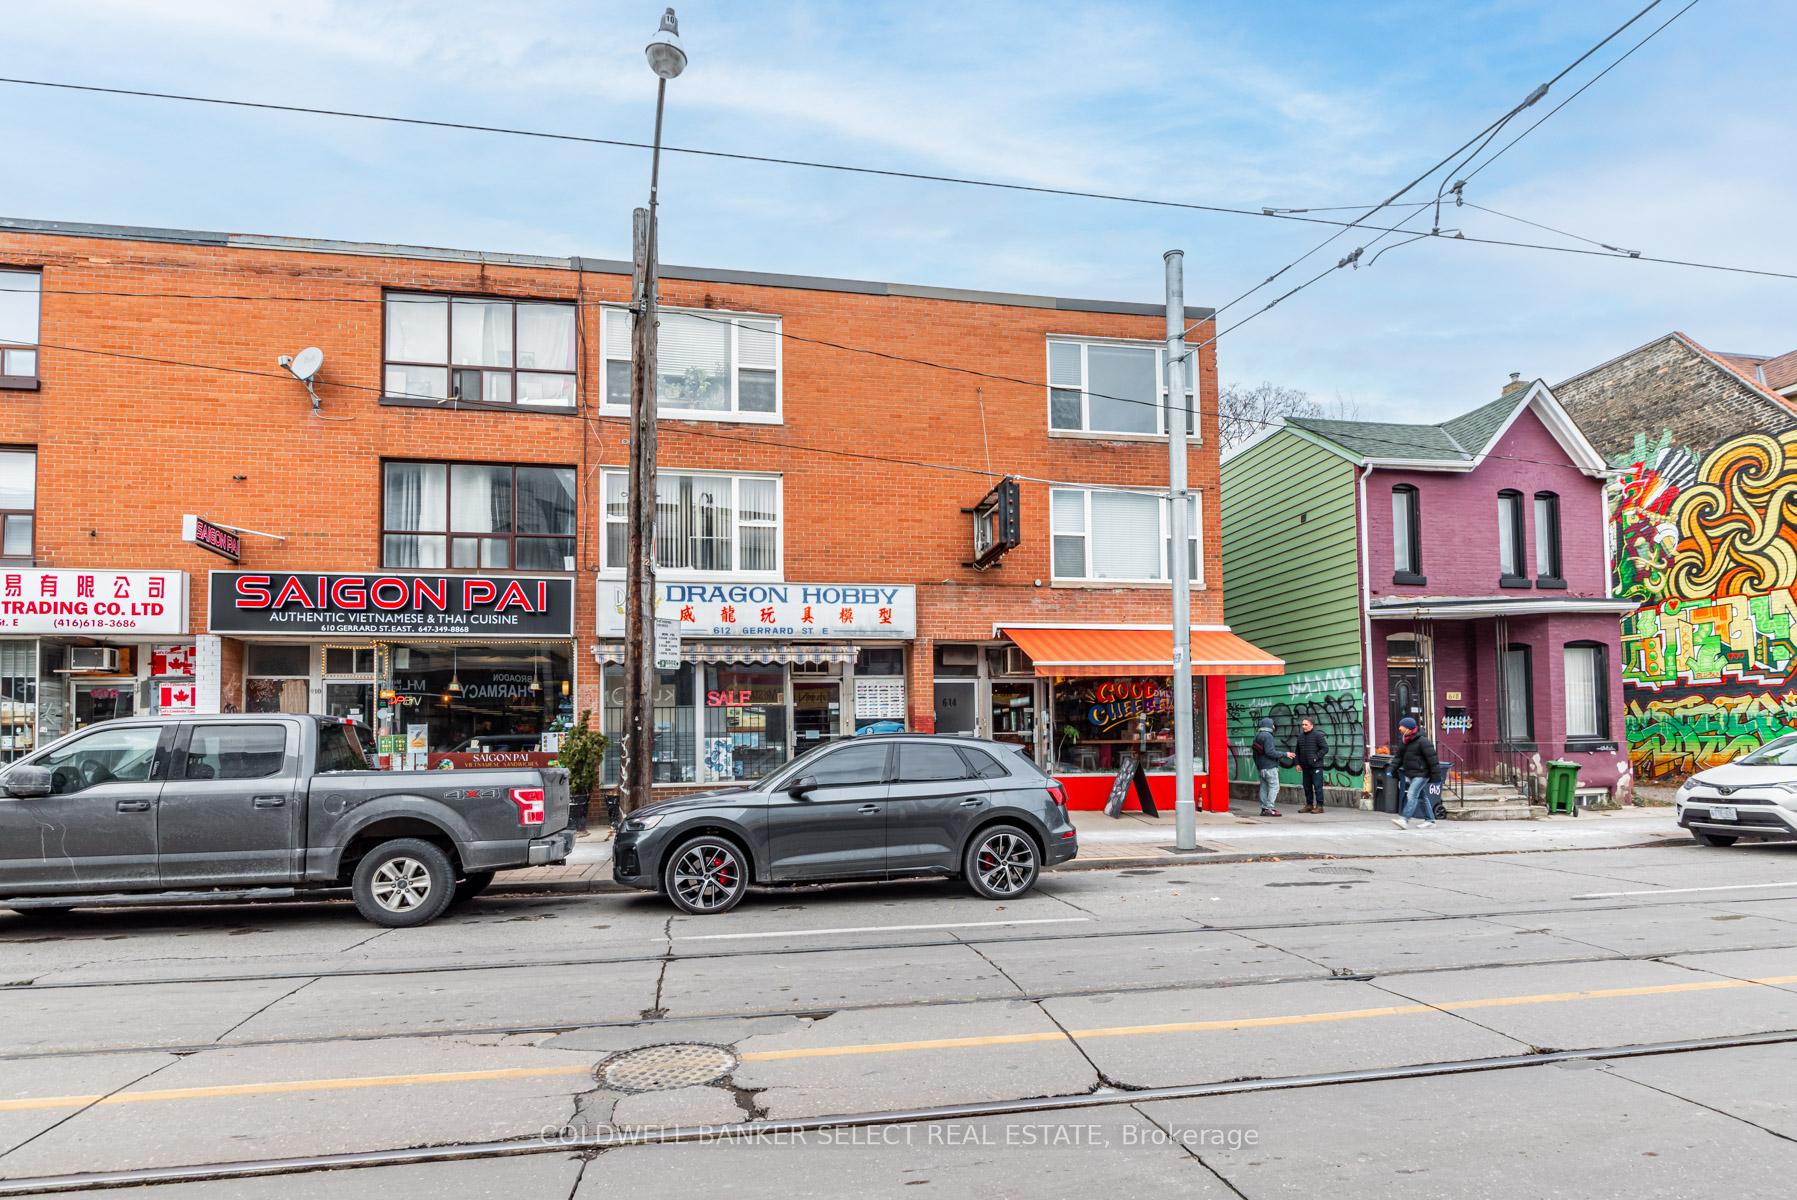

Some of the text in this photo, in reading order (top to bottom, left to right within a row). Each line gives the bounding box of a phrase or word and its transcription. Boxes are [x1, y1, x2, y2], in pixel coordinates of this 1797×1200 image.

[666, 15, 675, 24] 10
[196, 522, 227, 550] SAIGON
[5, 574, 165, 599] 易有限公司
[235, 575, 547, 613] SAIGON PAI
[666, 585, 899, 605] DRAGON HOBBY
[1, 601, 164, 616] TRADING CO. LTD
[679, 604, 893, 625] 威龍玩具模型
[13, 618, 19, 627] E
[53, 618, 136, 628] (416)618-3686
[269, 611, 519, 625] AUTHENTIC VIETNAMESE & THAI CUISINE
[321, 624, 335, 632] 610
[337, 624, 377, 632] GERRARD
[418, 625, 469, 633] 647-349-8868
[713, 626, 731, 635] 612
[742, 626, 794, 635] GERRARD
[822, 627, 829, 635] E
[706, 690, 752, 707] SALE
[1096, 681, 1155, 703] GOOD
[473, 753, 529, 763] SAIGON PAI
